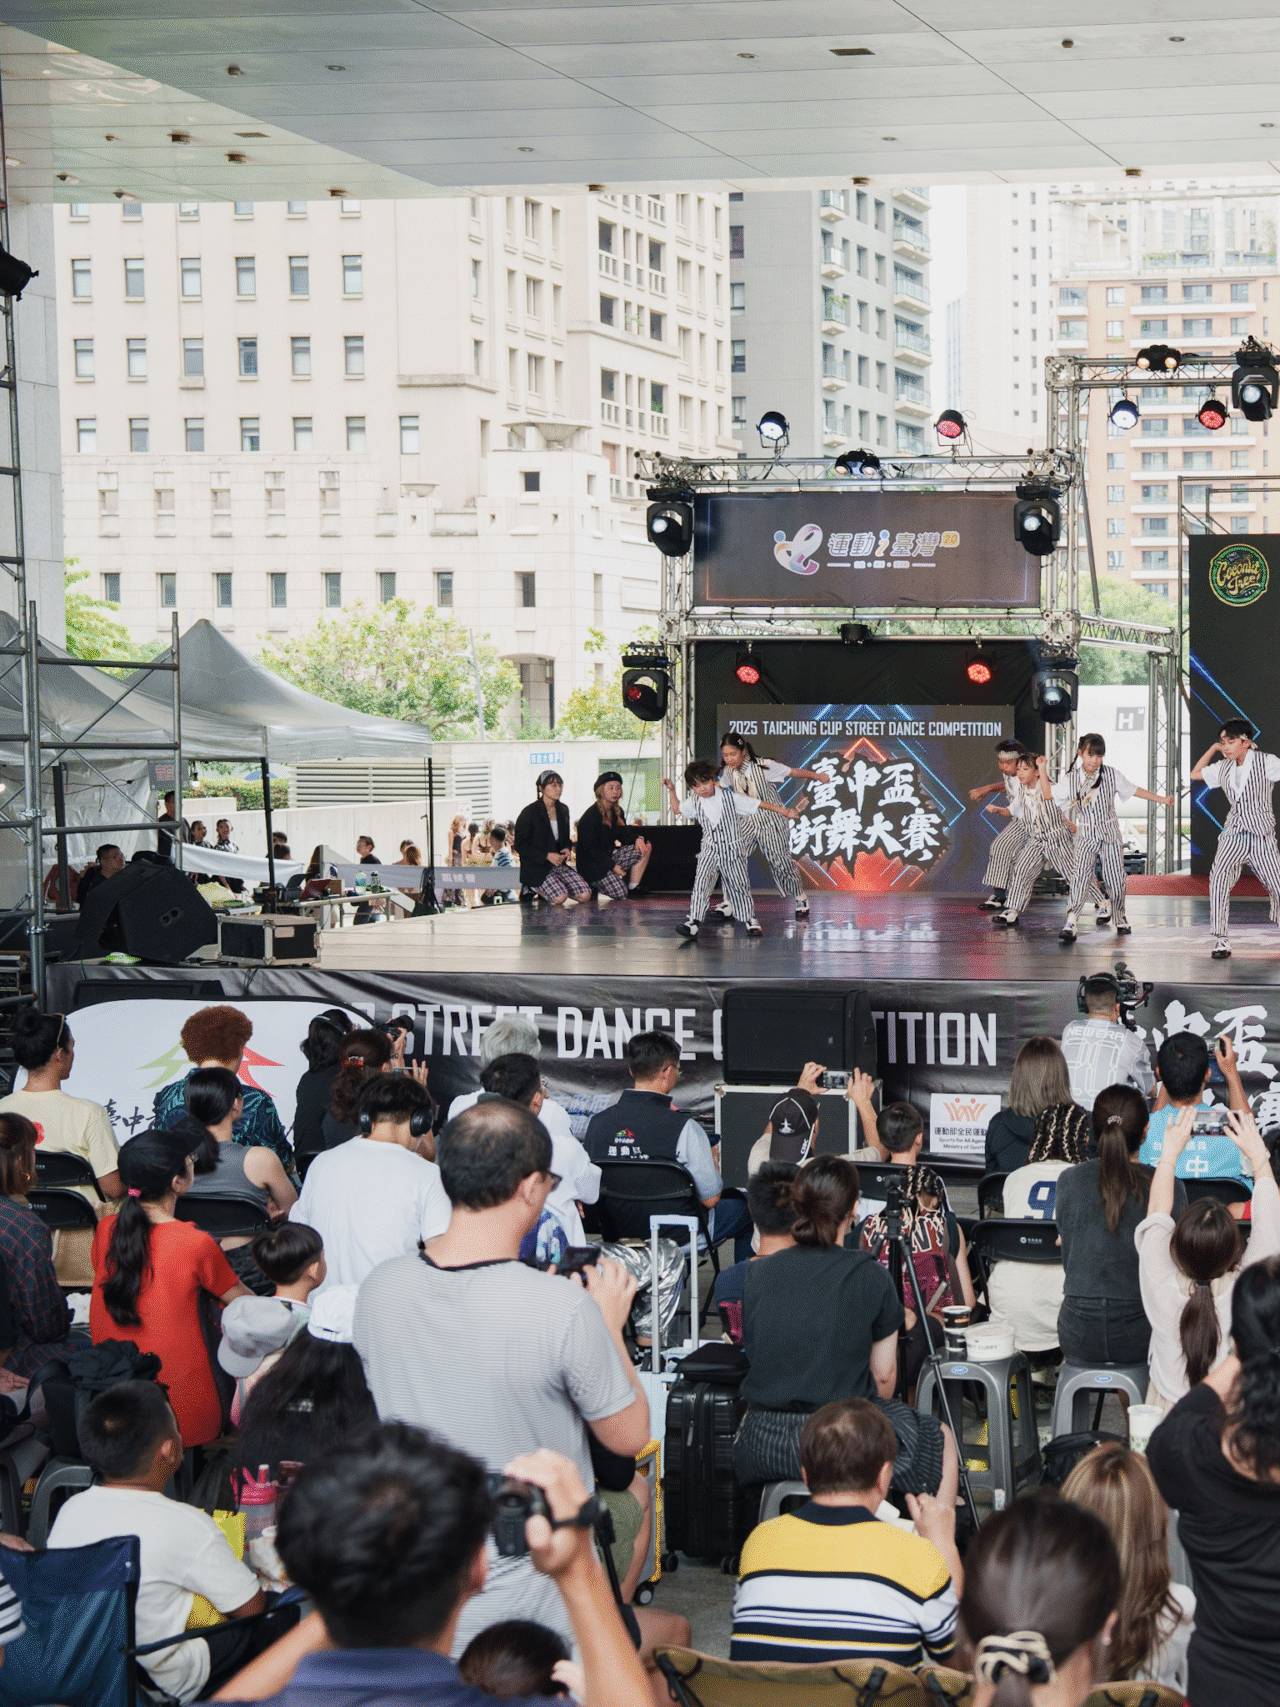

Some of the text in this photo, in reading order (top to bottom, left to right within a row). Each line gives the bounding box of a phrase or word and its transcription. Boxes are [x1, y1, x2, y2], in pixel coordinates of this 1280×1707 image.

[729, 721, 1001, 737] 2025 TAICHUNG CUP STREET DANCE COMPETITION
[806, 757, 921, 815] 臺中盃
[788, 808, 941, 861] 街舞大賽
[392, 1002, 543, 1056] STRE
[557, 1006, 697, 1061] DANCE
